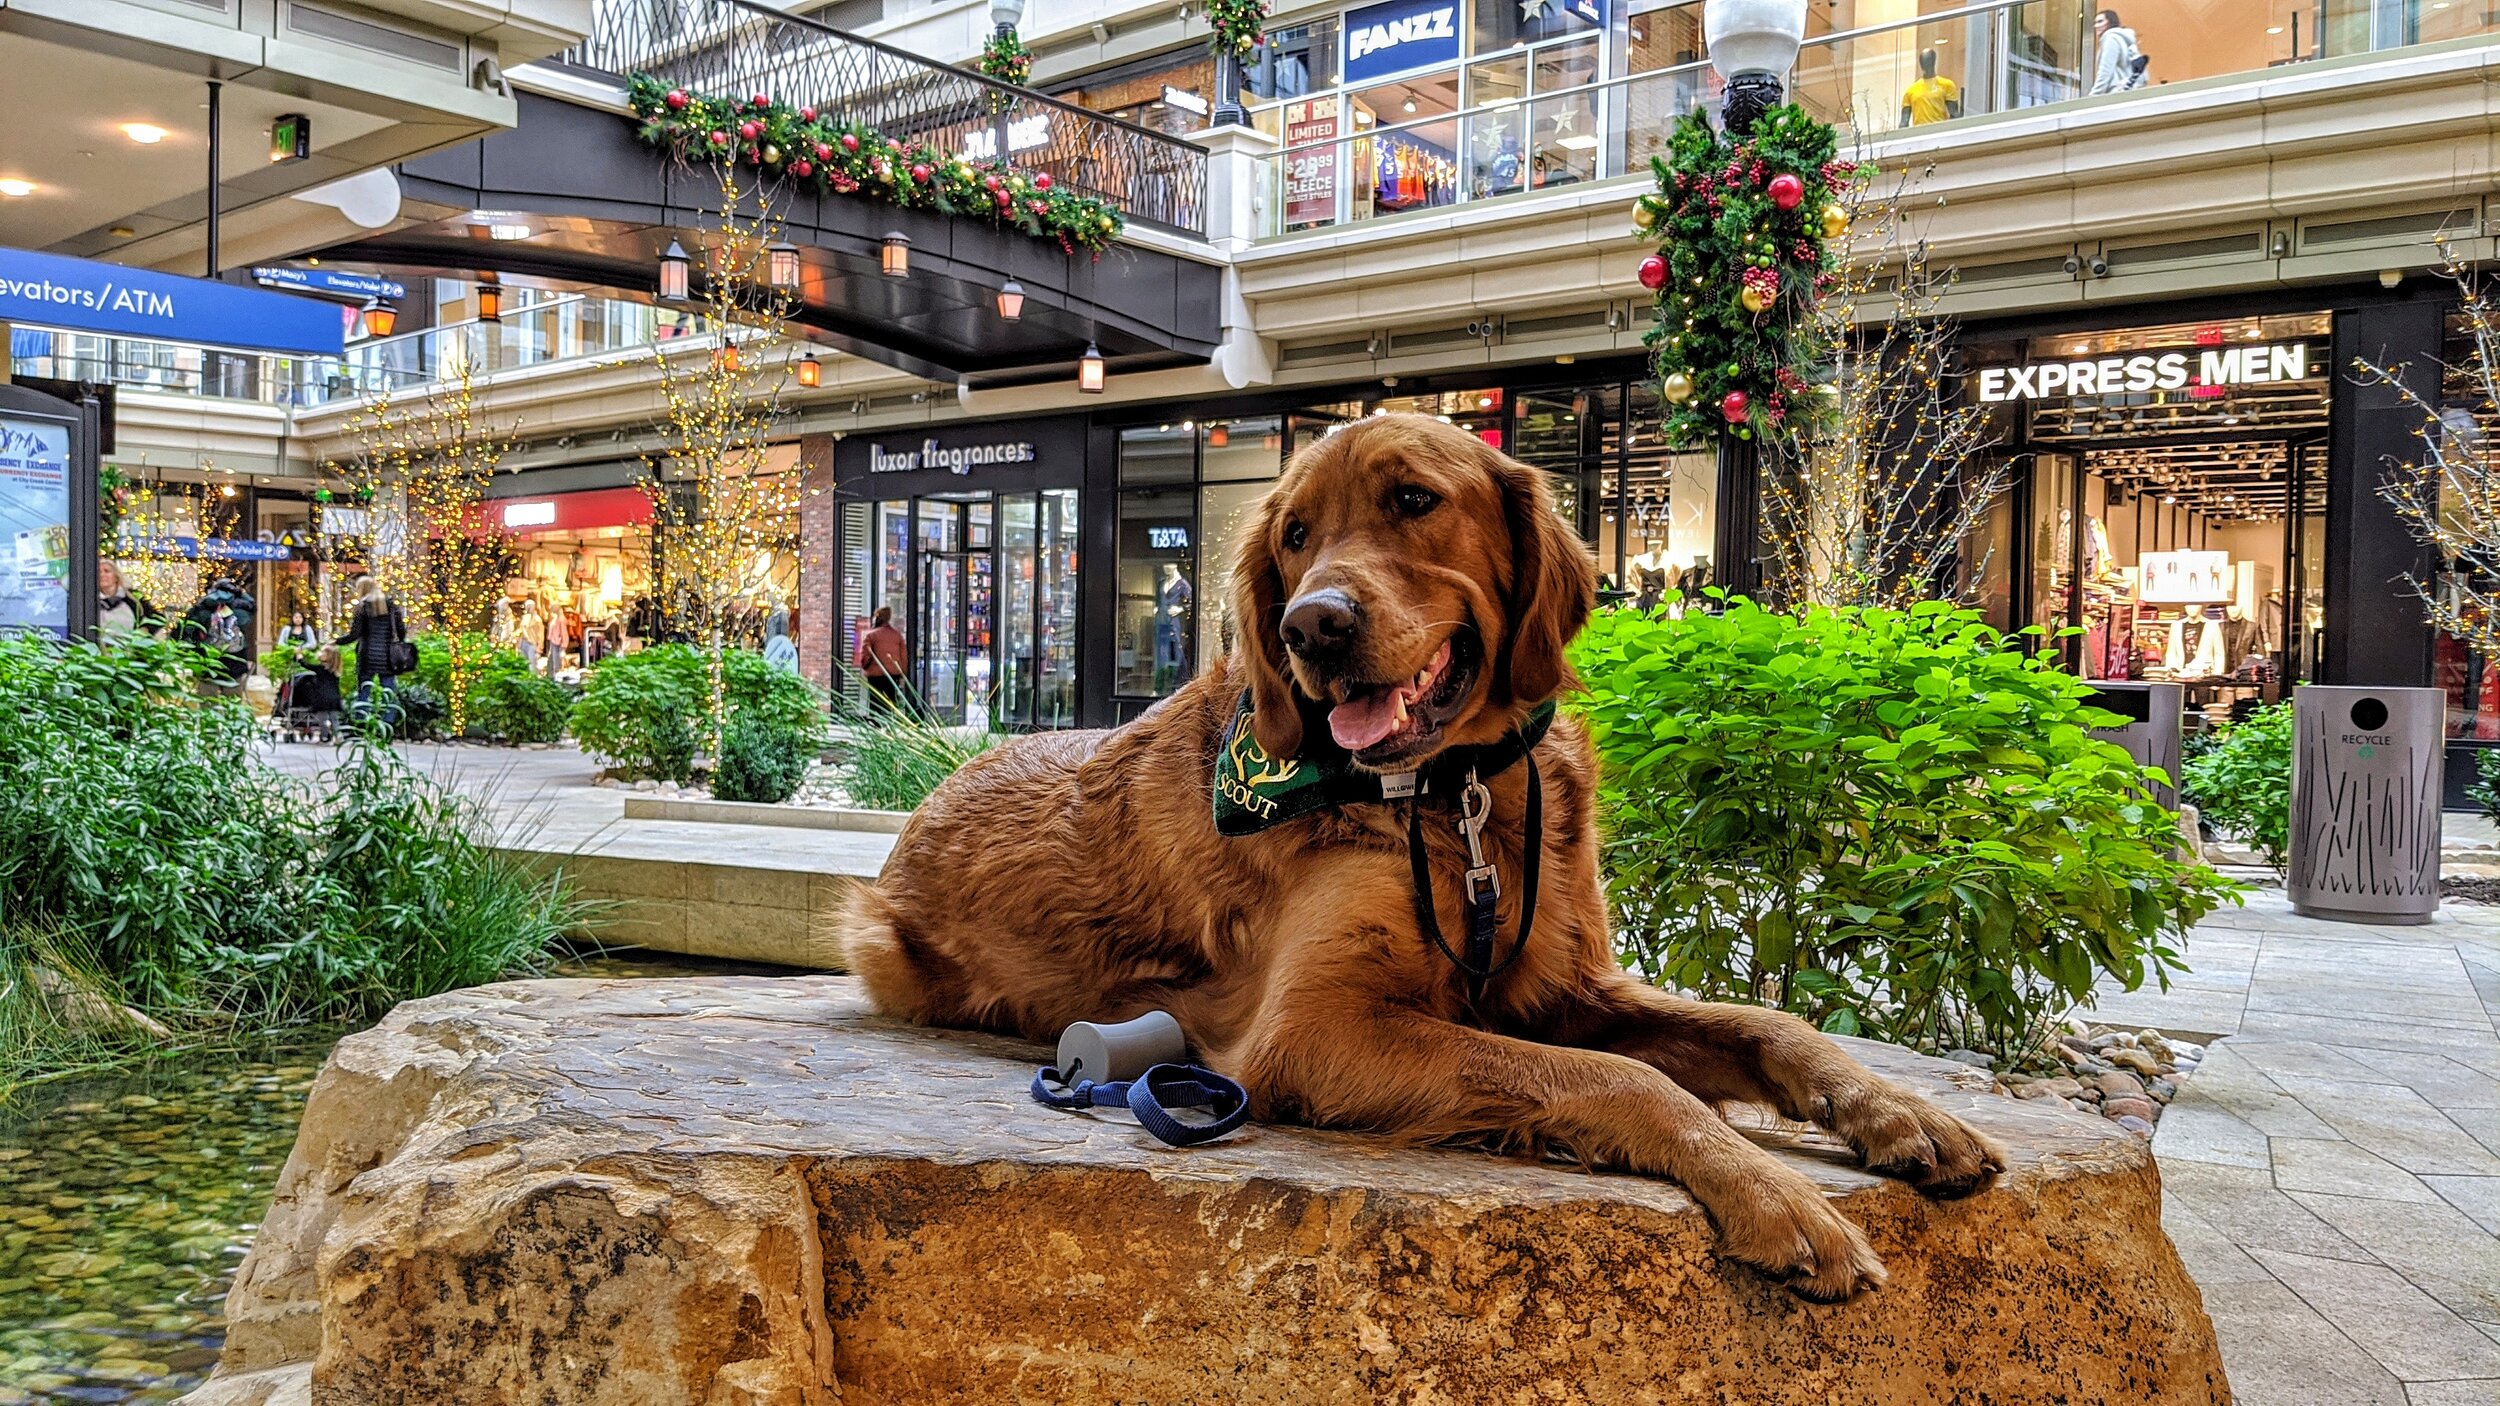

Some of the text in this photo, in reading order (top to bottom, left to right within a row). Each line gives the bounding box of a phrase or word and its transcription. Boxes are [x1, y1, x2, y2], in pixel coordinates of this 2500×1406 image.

[1349, 6, 1455, 62] FANZZ
[1289, 123, 1333, 141] LIMITED
[1286, 176, 1333, 195] FLEECE
[281, 269, 307, 282] Macy's
[1979, 344, 2304, 402] EXPRESS MEN
[870, 438, 1032, 476] luxor fragrances
[2342, 734, 2391, 746] RECYCLE
[1217, 772, 1278, 820] SCOUT
